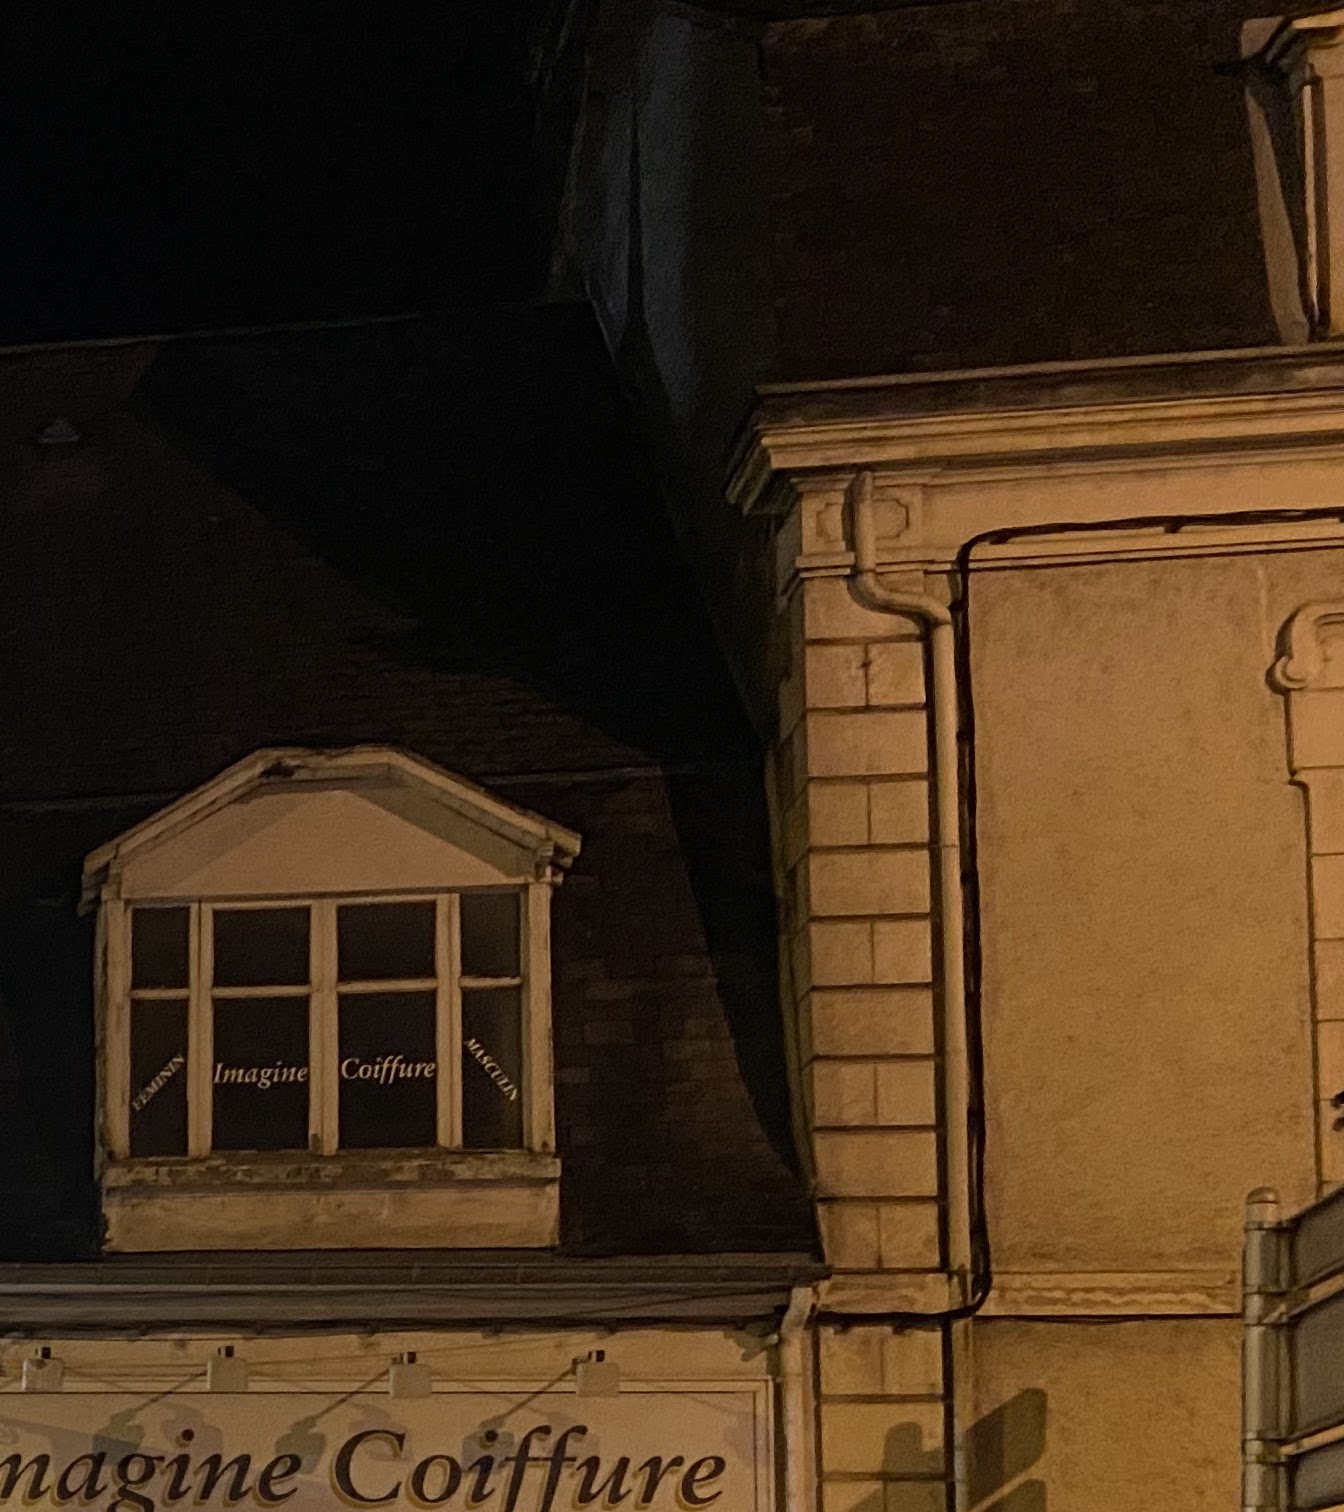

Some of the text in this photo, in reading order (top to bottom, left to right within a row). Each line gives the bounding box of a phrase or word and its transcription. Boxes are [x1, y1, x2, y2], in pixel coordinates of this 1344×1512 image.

[213, 1060, 309, 1089] Imagine
[340, 1055, 437, 1085] Coiffure
[464, 1037, 520, 1101] MASCULIN
